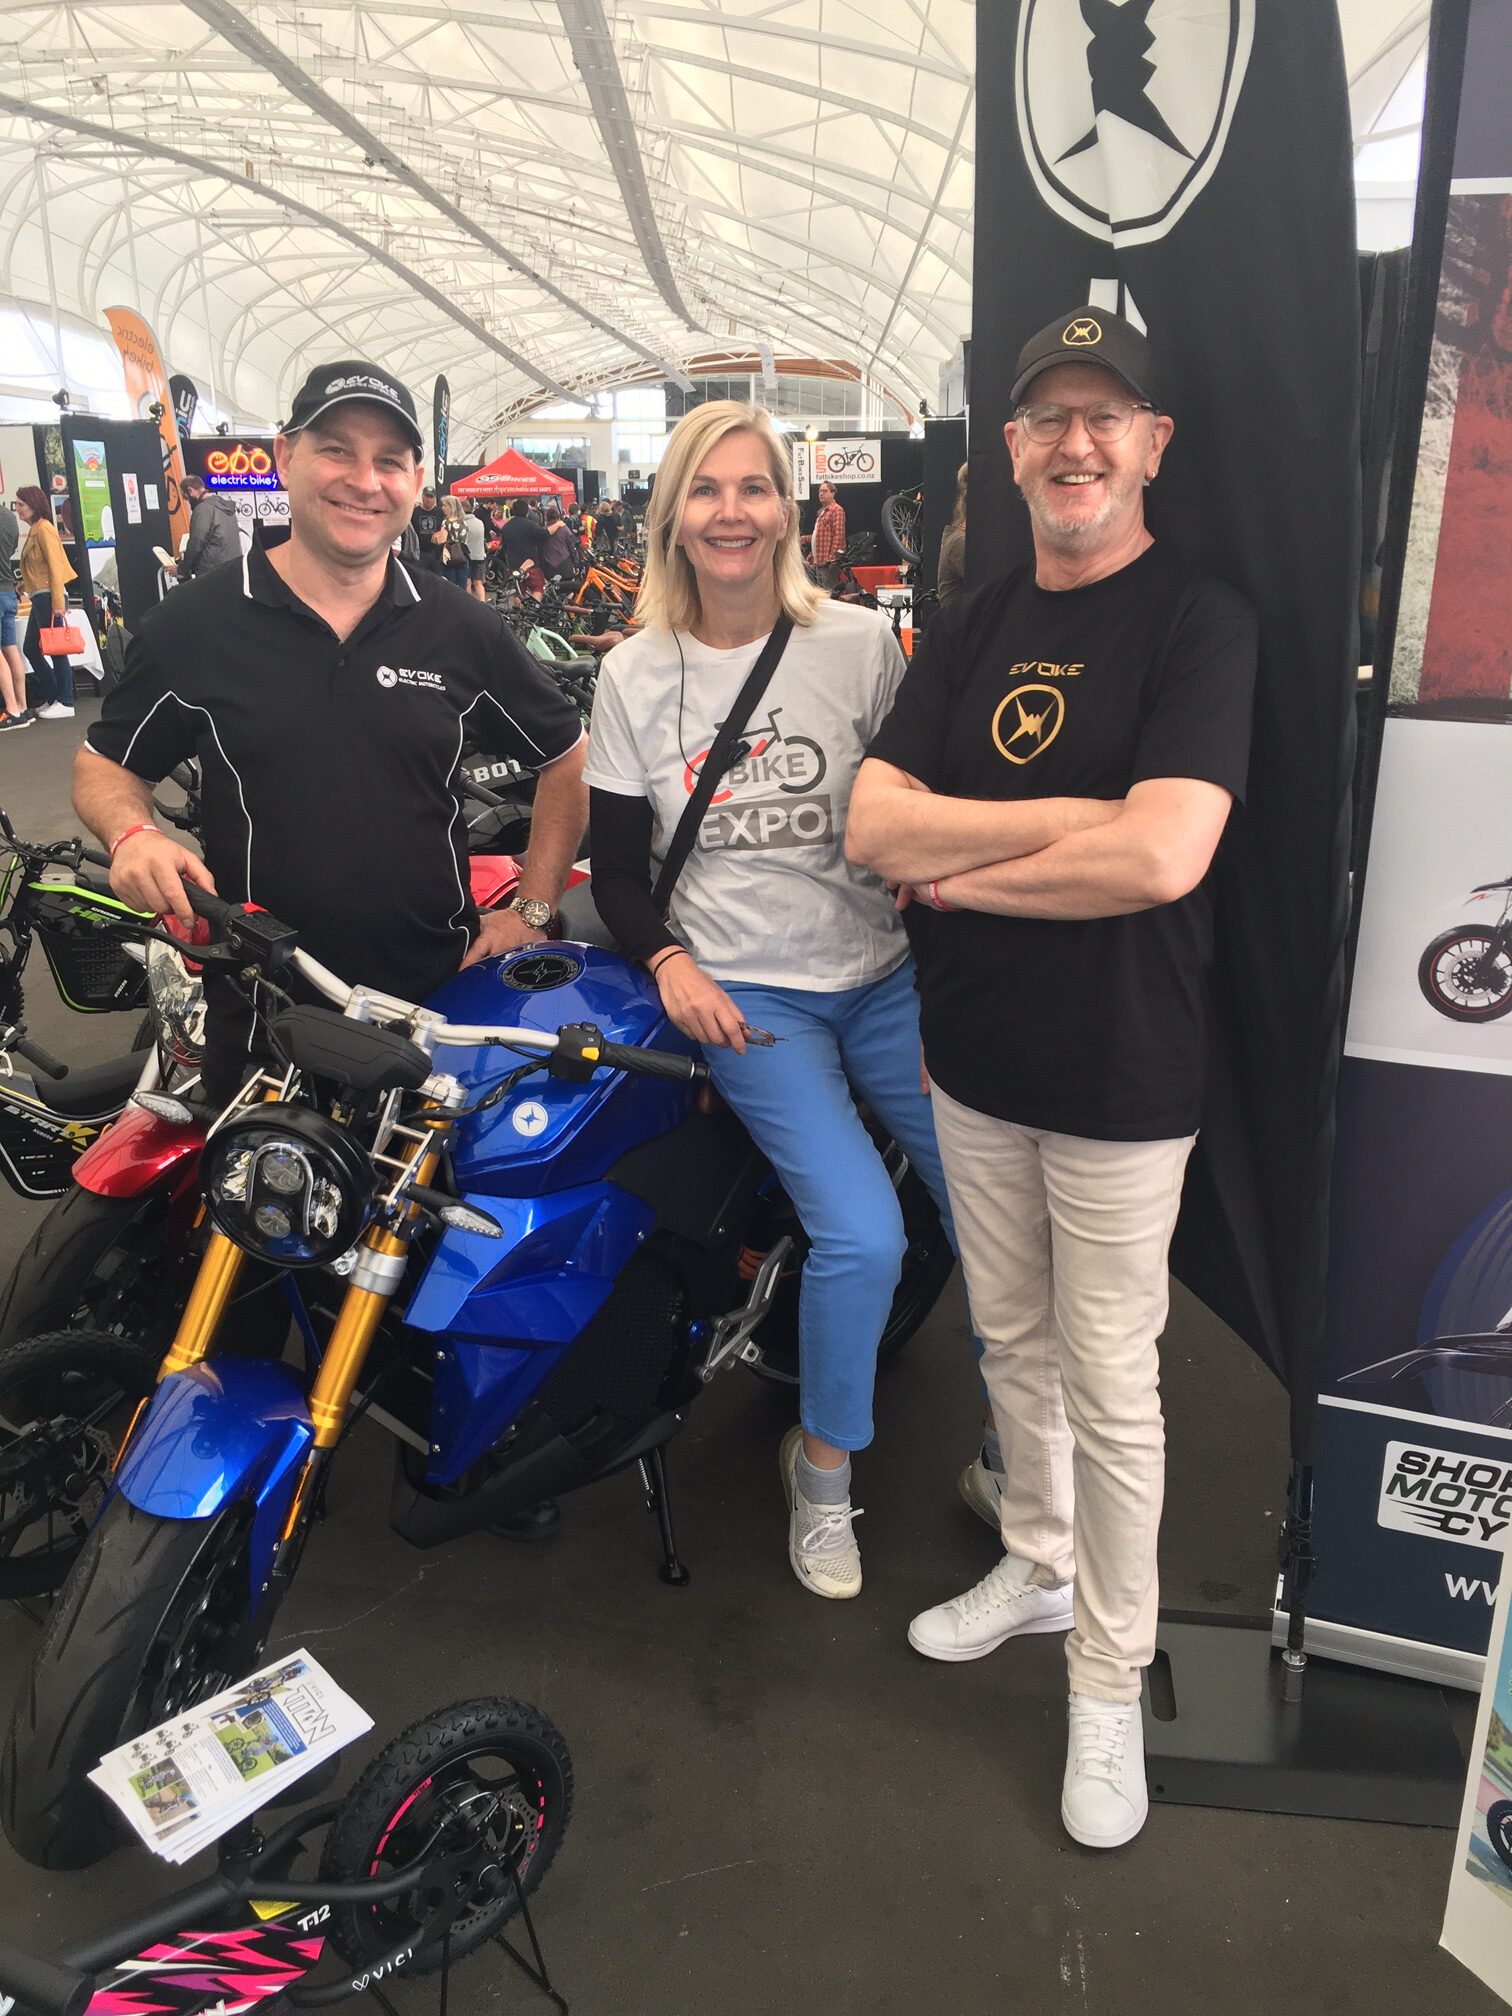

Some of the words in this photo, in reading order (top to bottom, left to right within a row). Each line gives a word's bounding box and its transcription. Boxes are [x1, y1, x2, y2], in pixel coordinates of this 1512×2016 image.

[346, 375, 399, 398] EVOKE
[210, 474, 249, 485] electric
[398, 667, 443, 684] EVOKE
[1008, 661, 1085, 677] EVOKE
[728, 752, 808, 785] BIKE
[699, 802, 828, 849] EXPO
[372, 1947, 414, 1980] VICI
